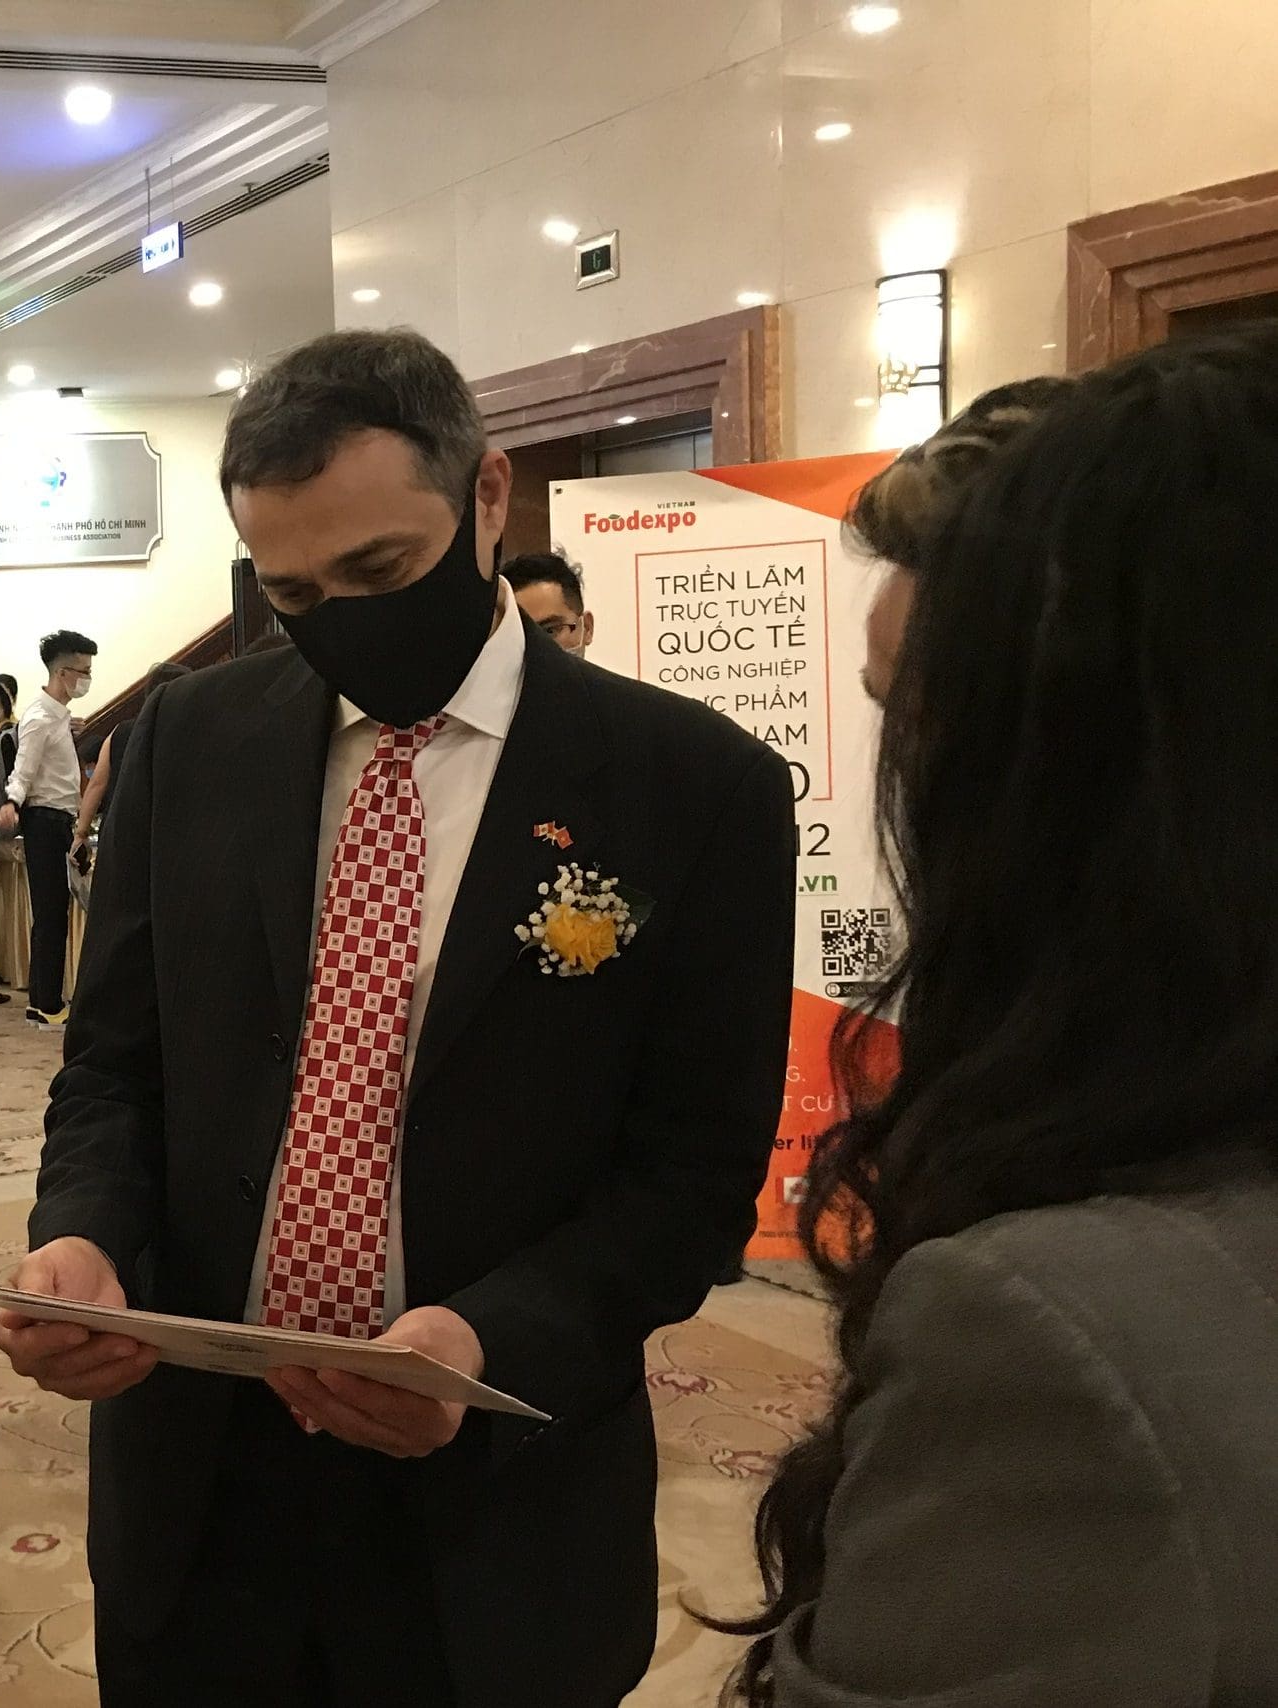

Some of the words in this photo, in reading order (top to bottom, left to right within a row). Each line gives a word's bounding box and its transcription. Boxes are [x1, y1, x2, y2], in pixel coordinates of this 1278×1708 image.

[657, 501, 696, 509] VIETNAM
[124, 519, 146, 529] MINH
[584, 510, 697, 534] Foodexpo
[655, 564, 735, 595] TRIỂN
[746, 564, 804, 589] LÃM
[656, 600, 718, 624] TRỰC
[726, 591, 805, 617] TUYẾN
[657, 620, 755, 656] QUỐC
[766, 615, 806, 648] TẾ
[658, 664, 720, 683] CÔNG
[728, 658, 807, 680] NGHIỆP
[735, 684, 807, 712] PHẨM
[753, 723, 808, 746] AM
